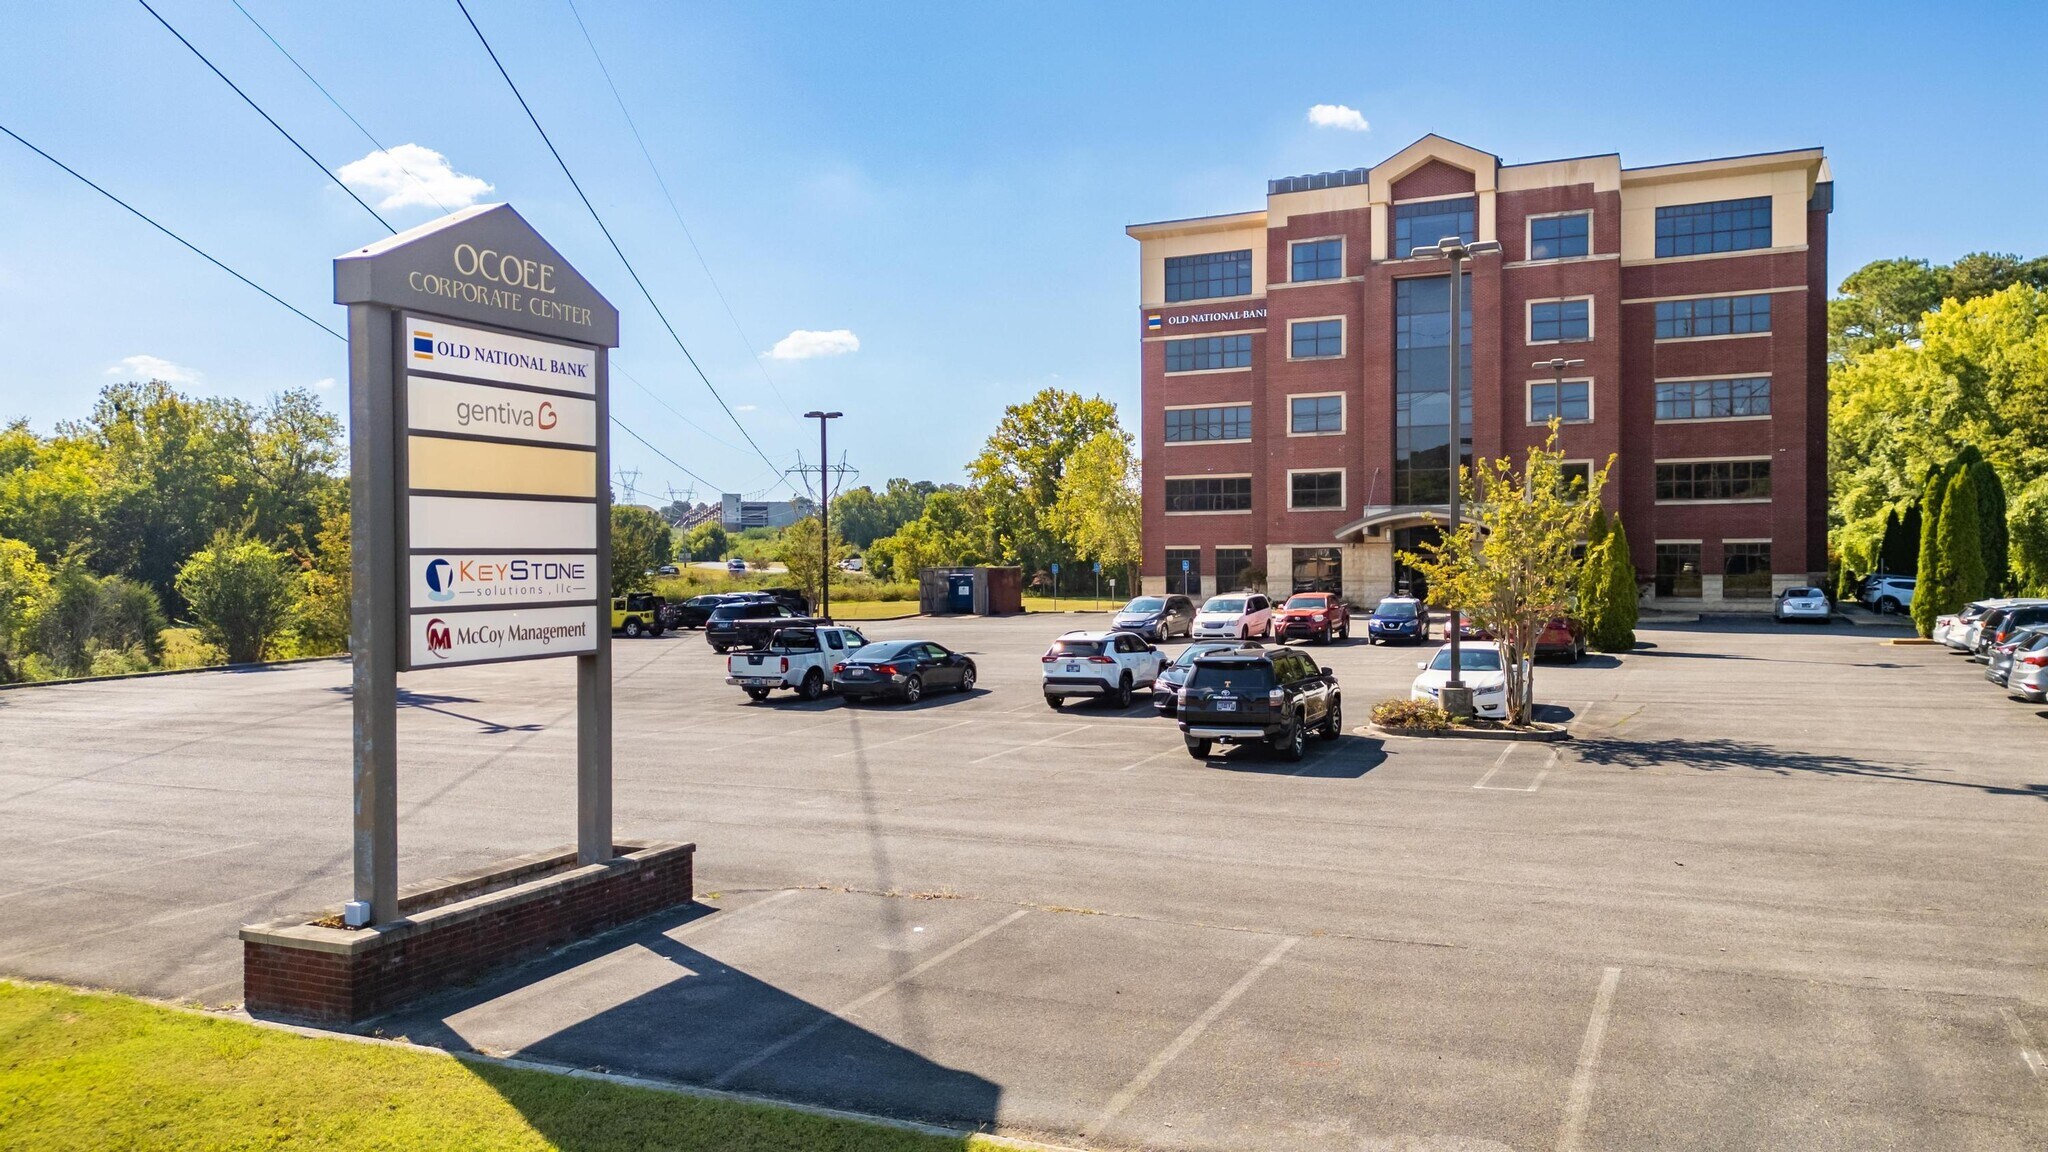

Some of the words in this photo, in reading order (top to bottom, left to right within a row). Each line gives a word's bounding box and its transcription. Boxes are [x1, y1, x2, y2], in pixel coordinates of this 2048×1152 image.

[454, 244, 556, 294] OCOEE
[409, 271, 522, 312] CORPORATE
[529, 298, 592, 326] CENTER
[1168, 315, 1189, 325] OLD
[1191, 310, 1239, 323] NATIONAL
[1242, 308, 1267, 319] BAN
[437, 341, 470, 359] OLD
[475, 347, 547, 372] NATIONAL
[550, 359, 587, 378] BANK
[457, 402, 534, 427] gentiva
[456, 625, 505, 648] McCoy
[508, 621, 587, 645] Management
